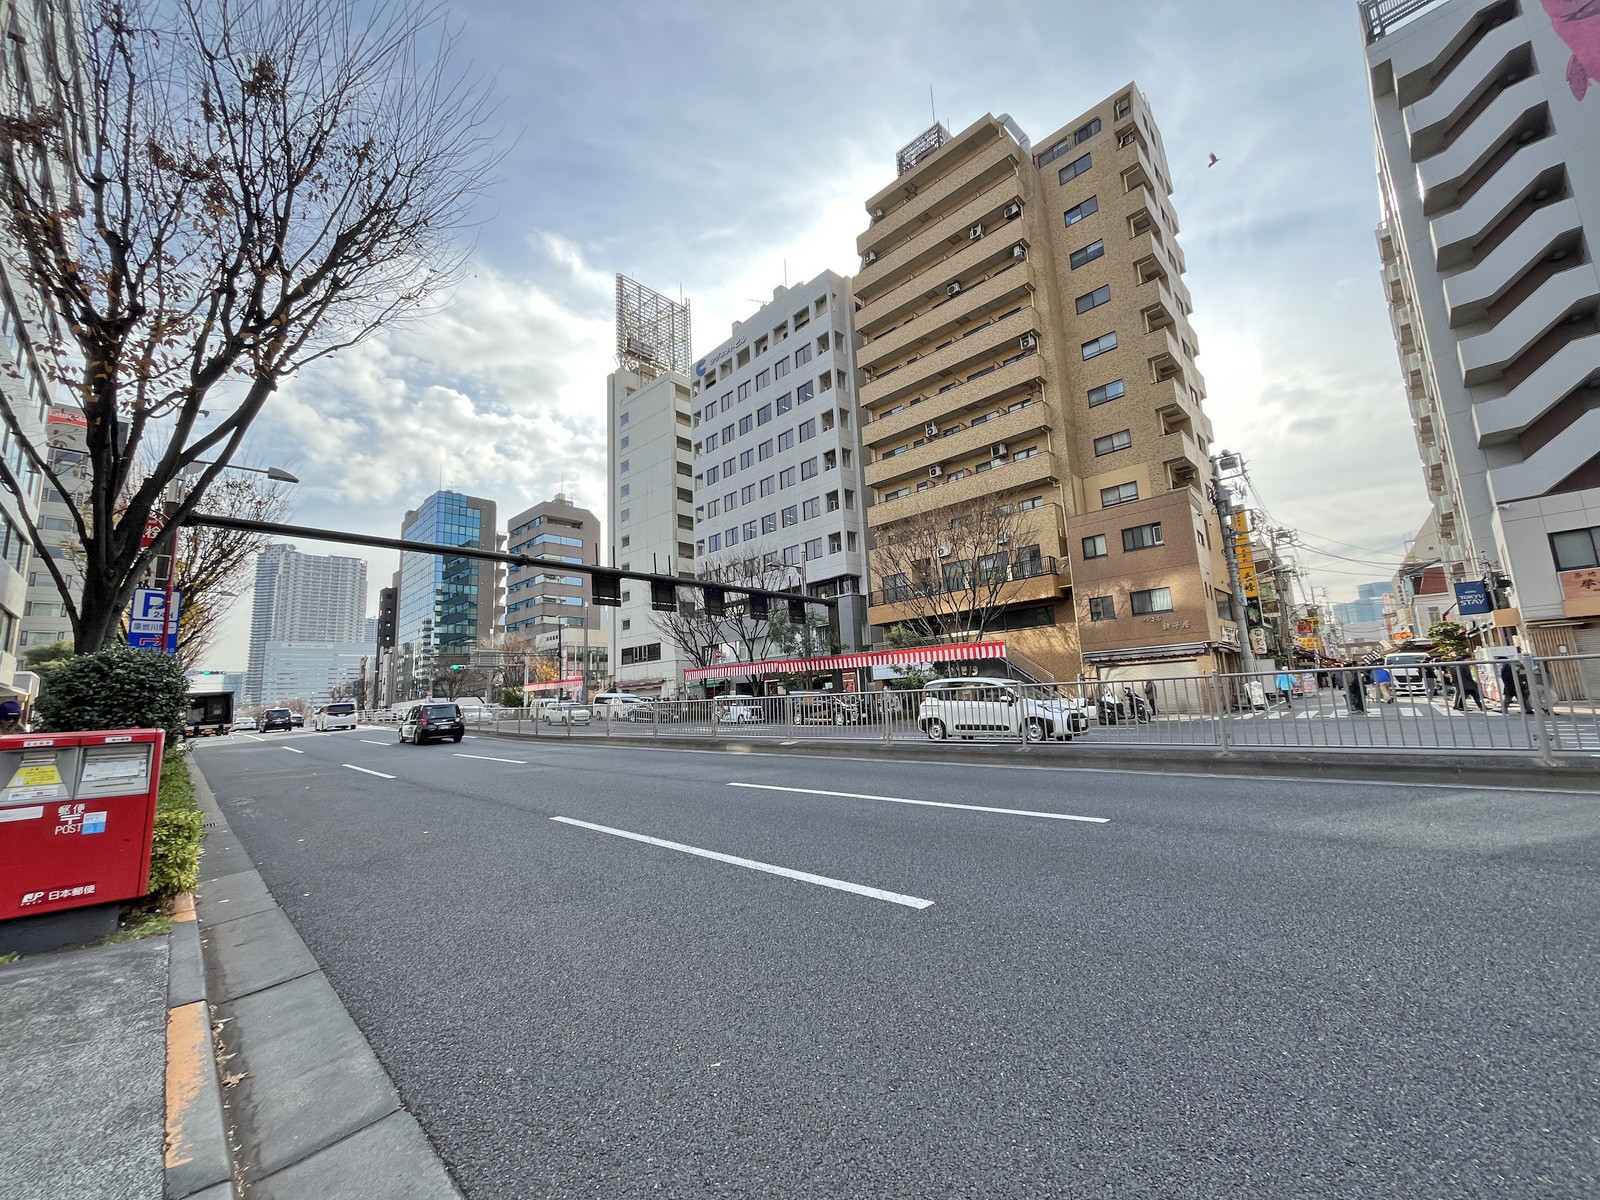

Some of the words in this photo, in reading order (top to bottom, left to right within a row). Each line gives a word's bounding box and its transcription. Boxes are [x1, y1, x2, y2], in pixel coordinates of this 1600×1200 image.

[142, 592, 167, 617] P
[58, 803, 86, 816] 郵便
[55, 822, 83, 835] POST
[48, 884, 96, 900] 日本郵便
